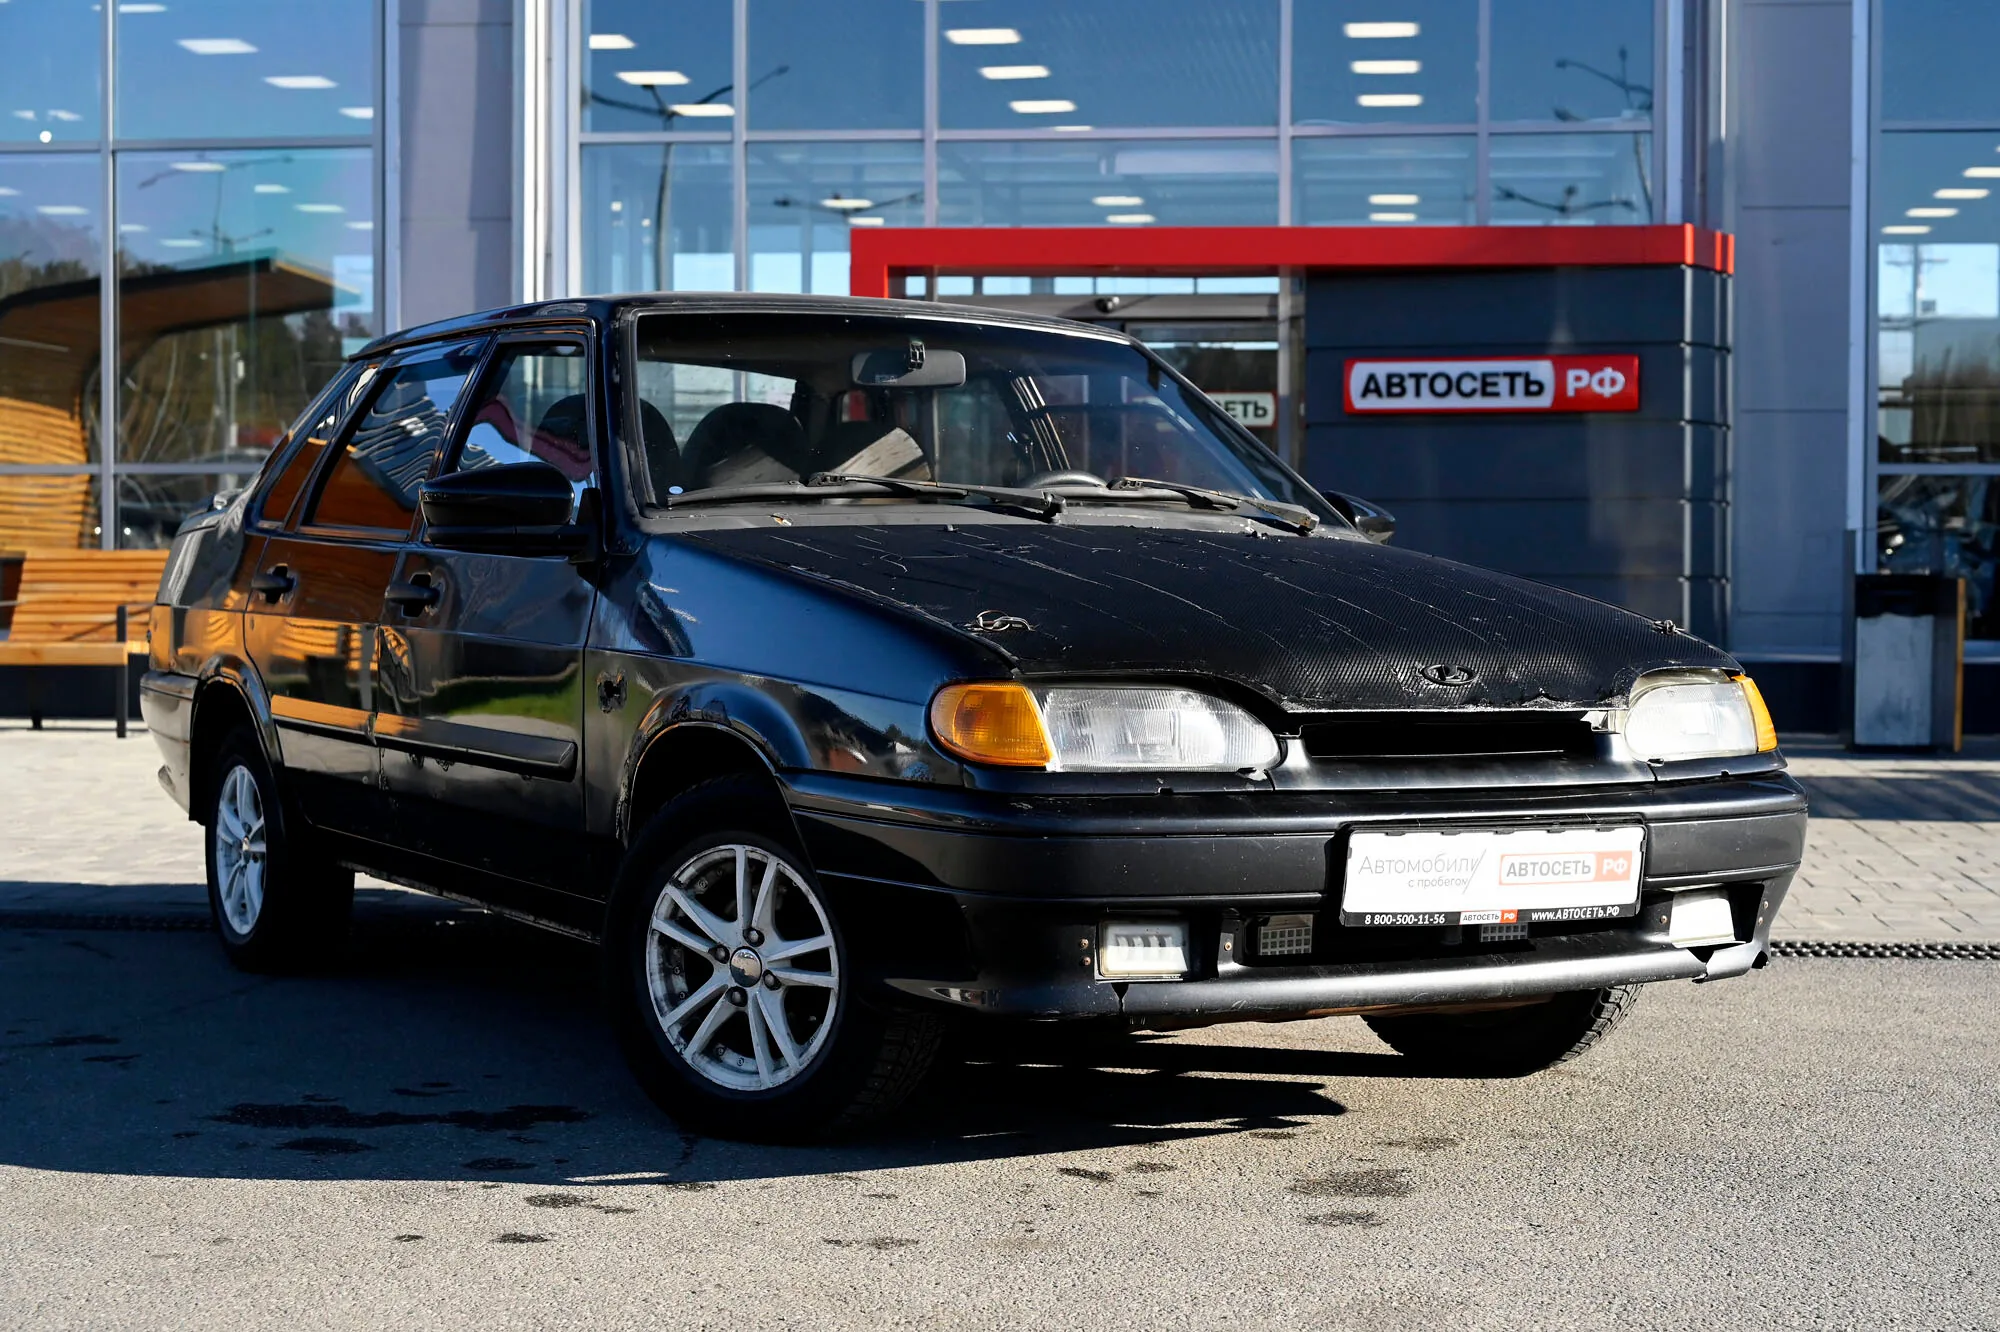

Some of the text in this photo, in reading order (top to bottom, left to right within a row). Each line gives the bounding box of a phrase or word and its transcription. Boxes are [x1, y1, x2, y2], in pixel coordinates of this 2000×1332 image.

[1360, 366, 1626, 399] АВТОСЕТЬ РФ
[1215, 400, 1268, 419] ЕТЬ
[1358, 852, 1480, 875] Автомобили
[1506, 857, 1628, 877] АВТОСЕТЬ РФ
[1417, 875, 1468, 889] пробегом
[1364, 913, 1446, 925] 8 800-500-11-56
[1463, 912, 1515, 922] АВТОСЕТЬ РФ
[1531, 905, 1620, 921] www.АВТОСЕТЬ.РФ
